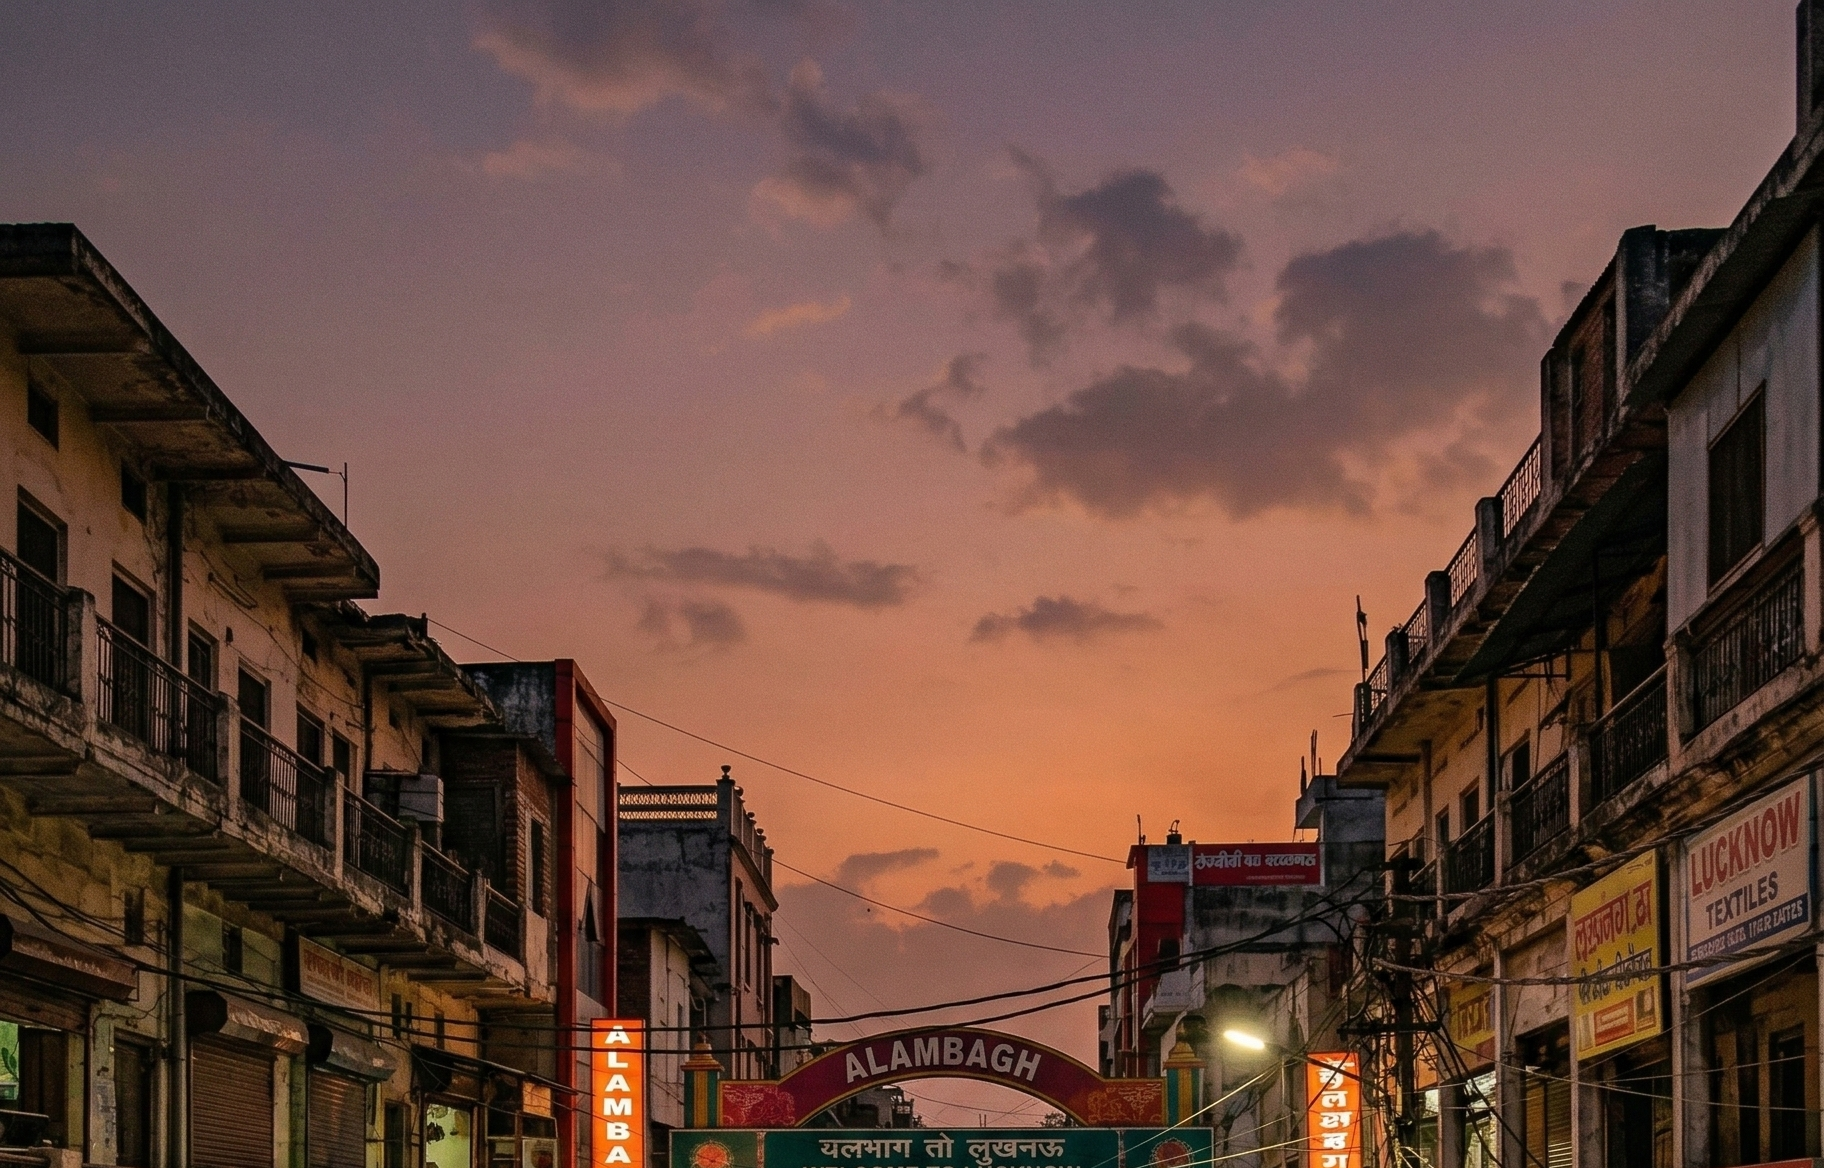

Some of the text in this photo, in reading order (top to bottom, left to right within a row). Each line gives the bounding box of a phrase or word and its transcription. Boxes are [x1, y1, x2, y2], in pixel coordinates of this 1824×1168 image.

[1691, 791, 1801, 898] LUCKNOW
[1706, 870, 1779, 930] TEXTILES
[845, 1036, 1042, 1084] ALAMBAGH
[923, 1132, 955, 1158] तो
